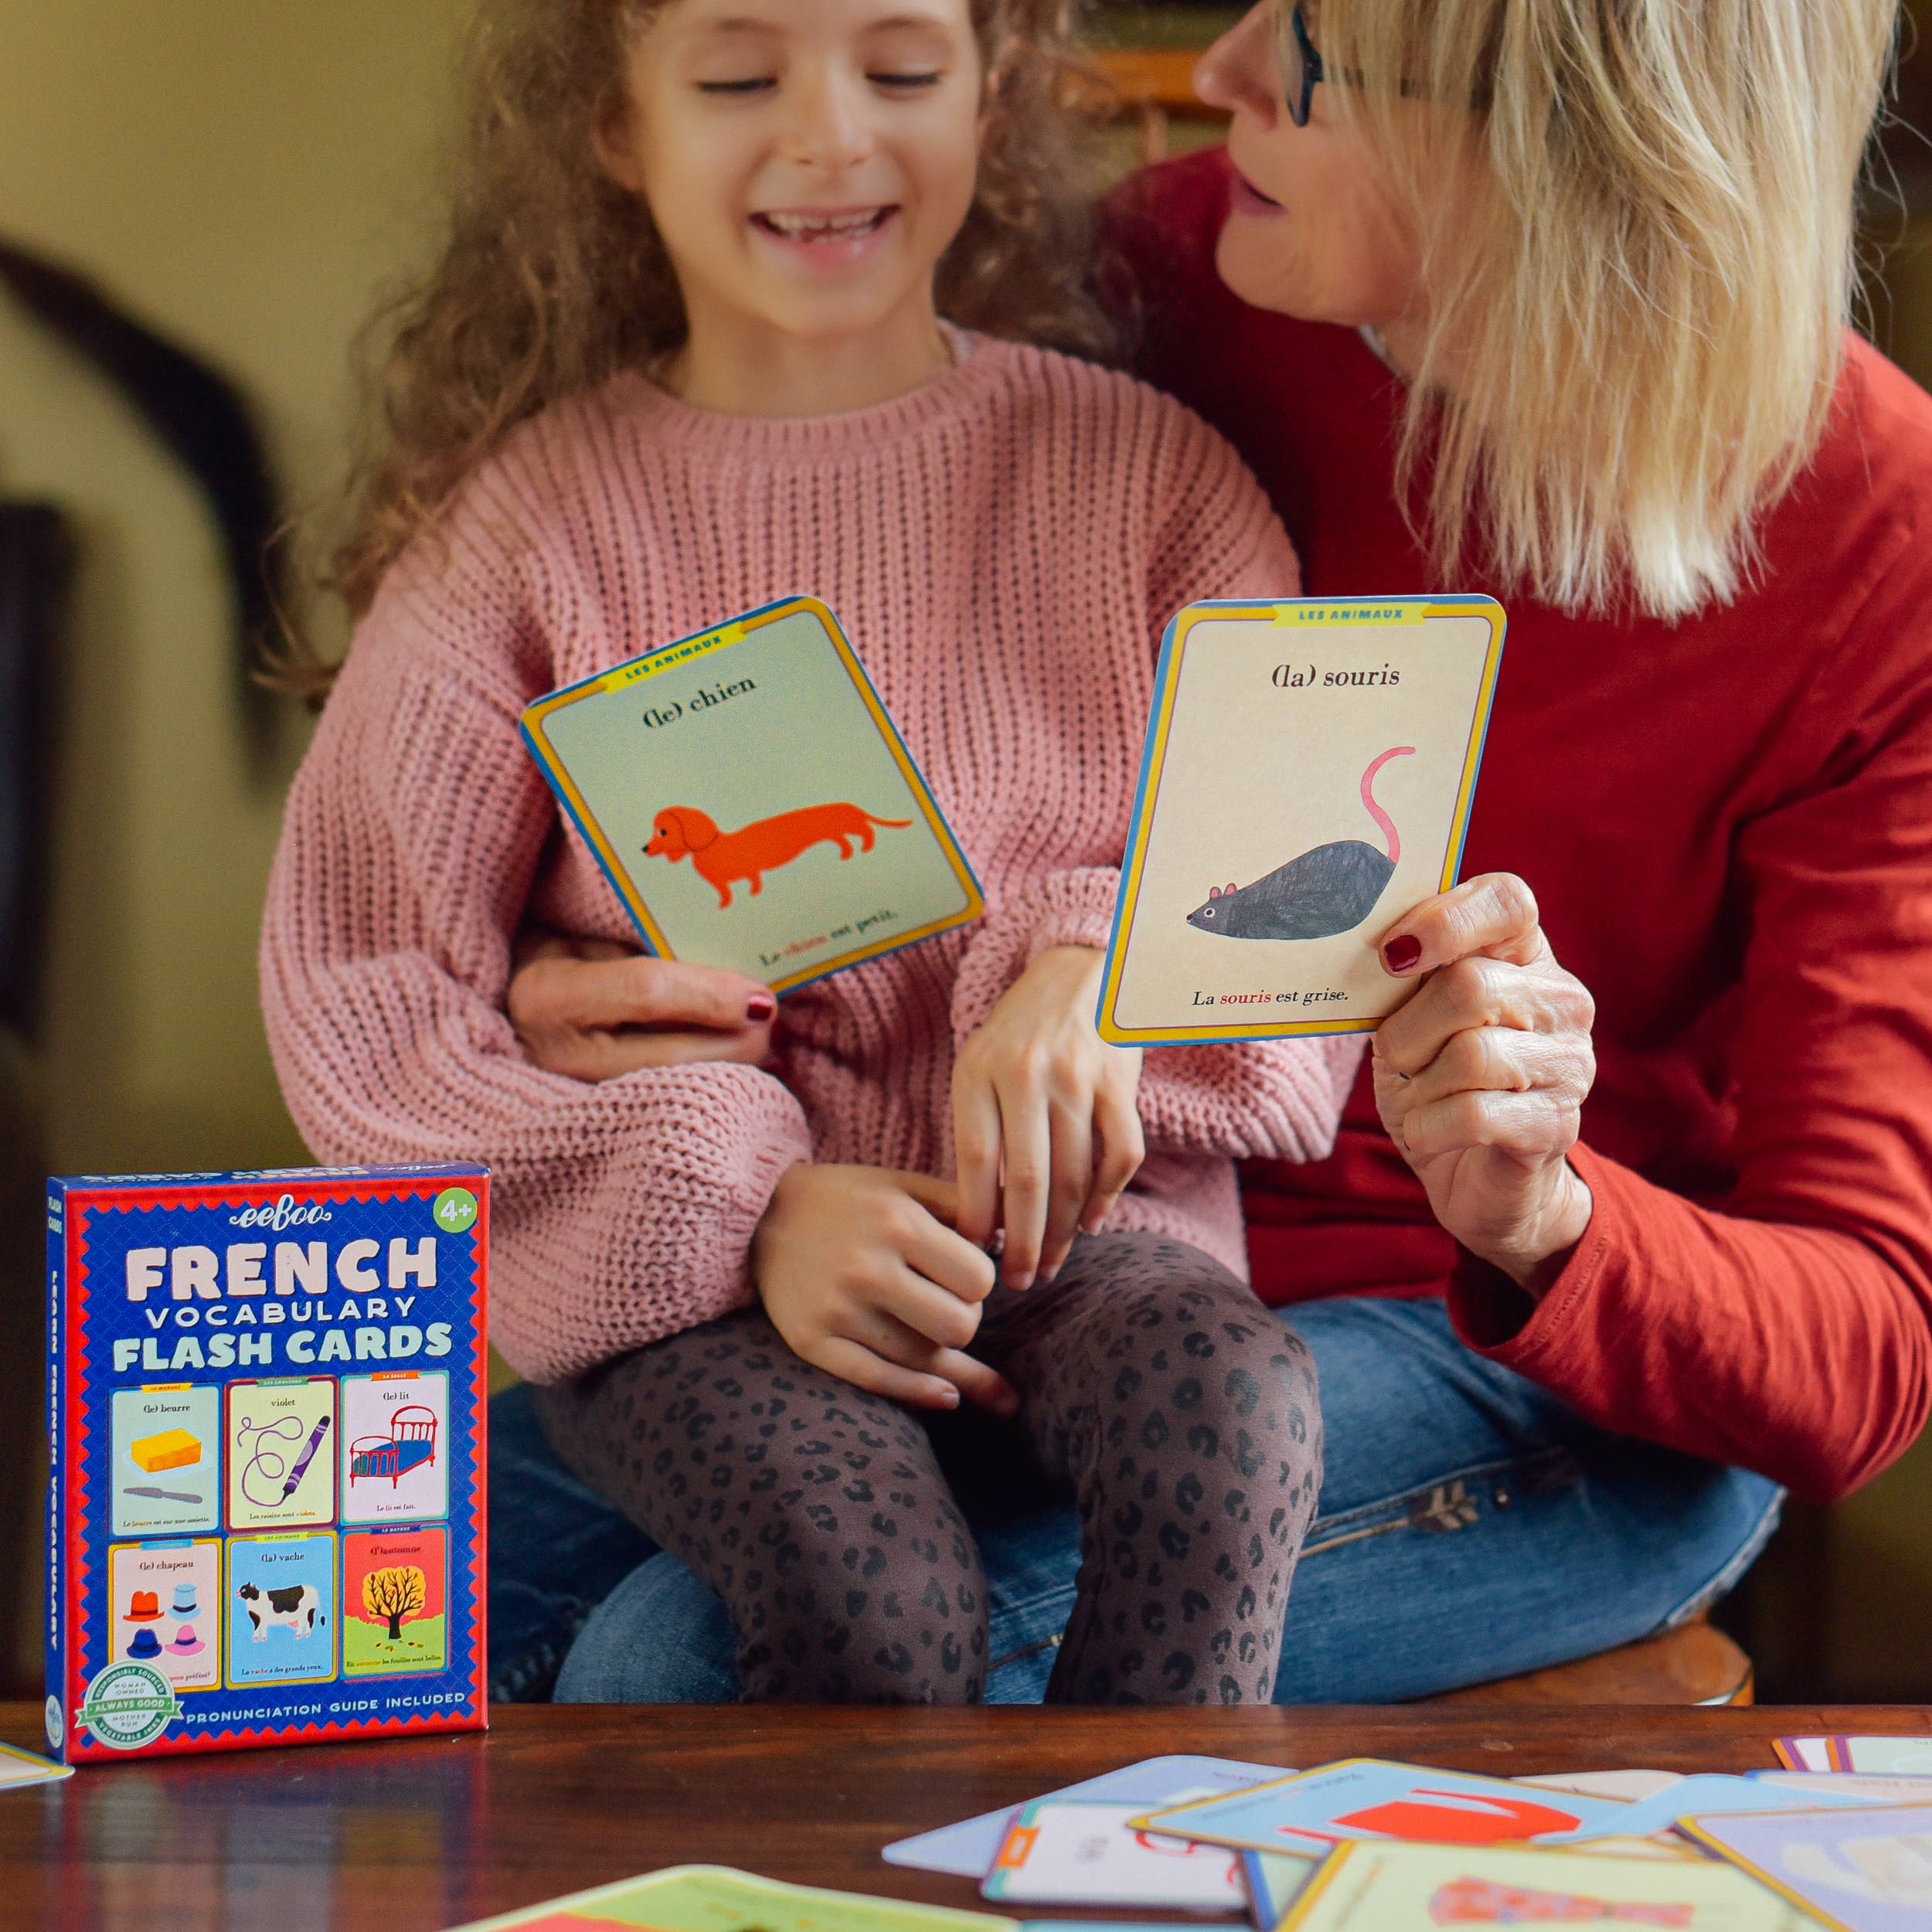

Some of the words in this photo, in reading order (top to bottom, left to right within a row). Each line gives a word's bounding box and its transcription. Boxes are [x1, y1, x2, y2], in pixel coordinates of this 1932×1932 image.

[1298, 610, 1324, 620] LES
[1330, 609, 1403, 620] ANIMAUX
[625, 664, 650, 679] LES
[655, 635, 722, 668] ANIMAUX
[1271, 663, 1316, 688] (la)
[1323, 662, 1400, 687] souris
[643, 701, 682, 729] (le)
[689, 678, 758, 712] chien
[760, 953, 781, 966] Le
[1192, 991, 1215, 1005] La
[1220, 989, 1271, 1005] souris
[1276, 991, 1298, 1002] est
[1302, 988, 1349, 1006] grise.
[440, 1199, 471, 1222] 4+
[125, 1236, 437, 1301] FRENCH
[145, 1296, 417, 1329] VOCABULARY
[113, 1332, 273, 1372] FLASH
[285, 1322, 453, 1364] CARDS
[271, 1397, 296, 1406] violet
[383, 1392, 397, 1400] (le)
[400, 1391, 410, 1400] lit
[143, 1404, 158, 1413] (le)
[161, 1404, 191, 1413] beurre
[139, 1562, 155, 1570] (le)
[156, 1560, 194, 1571] chapeau
[261, 1553, 277, 1563] (la)
[279, 1552, 304, 1561] vache
[95, 1699, 134, 1712] ALWAYS
[137, 1699, 165, 1708] GOOD
[185, 1702, 321, 1725] PRONUNCIATION
[329, 1699, 379, 1713] GUIDE
[386, 1692, 466, 1709] INCLUDED
